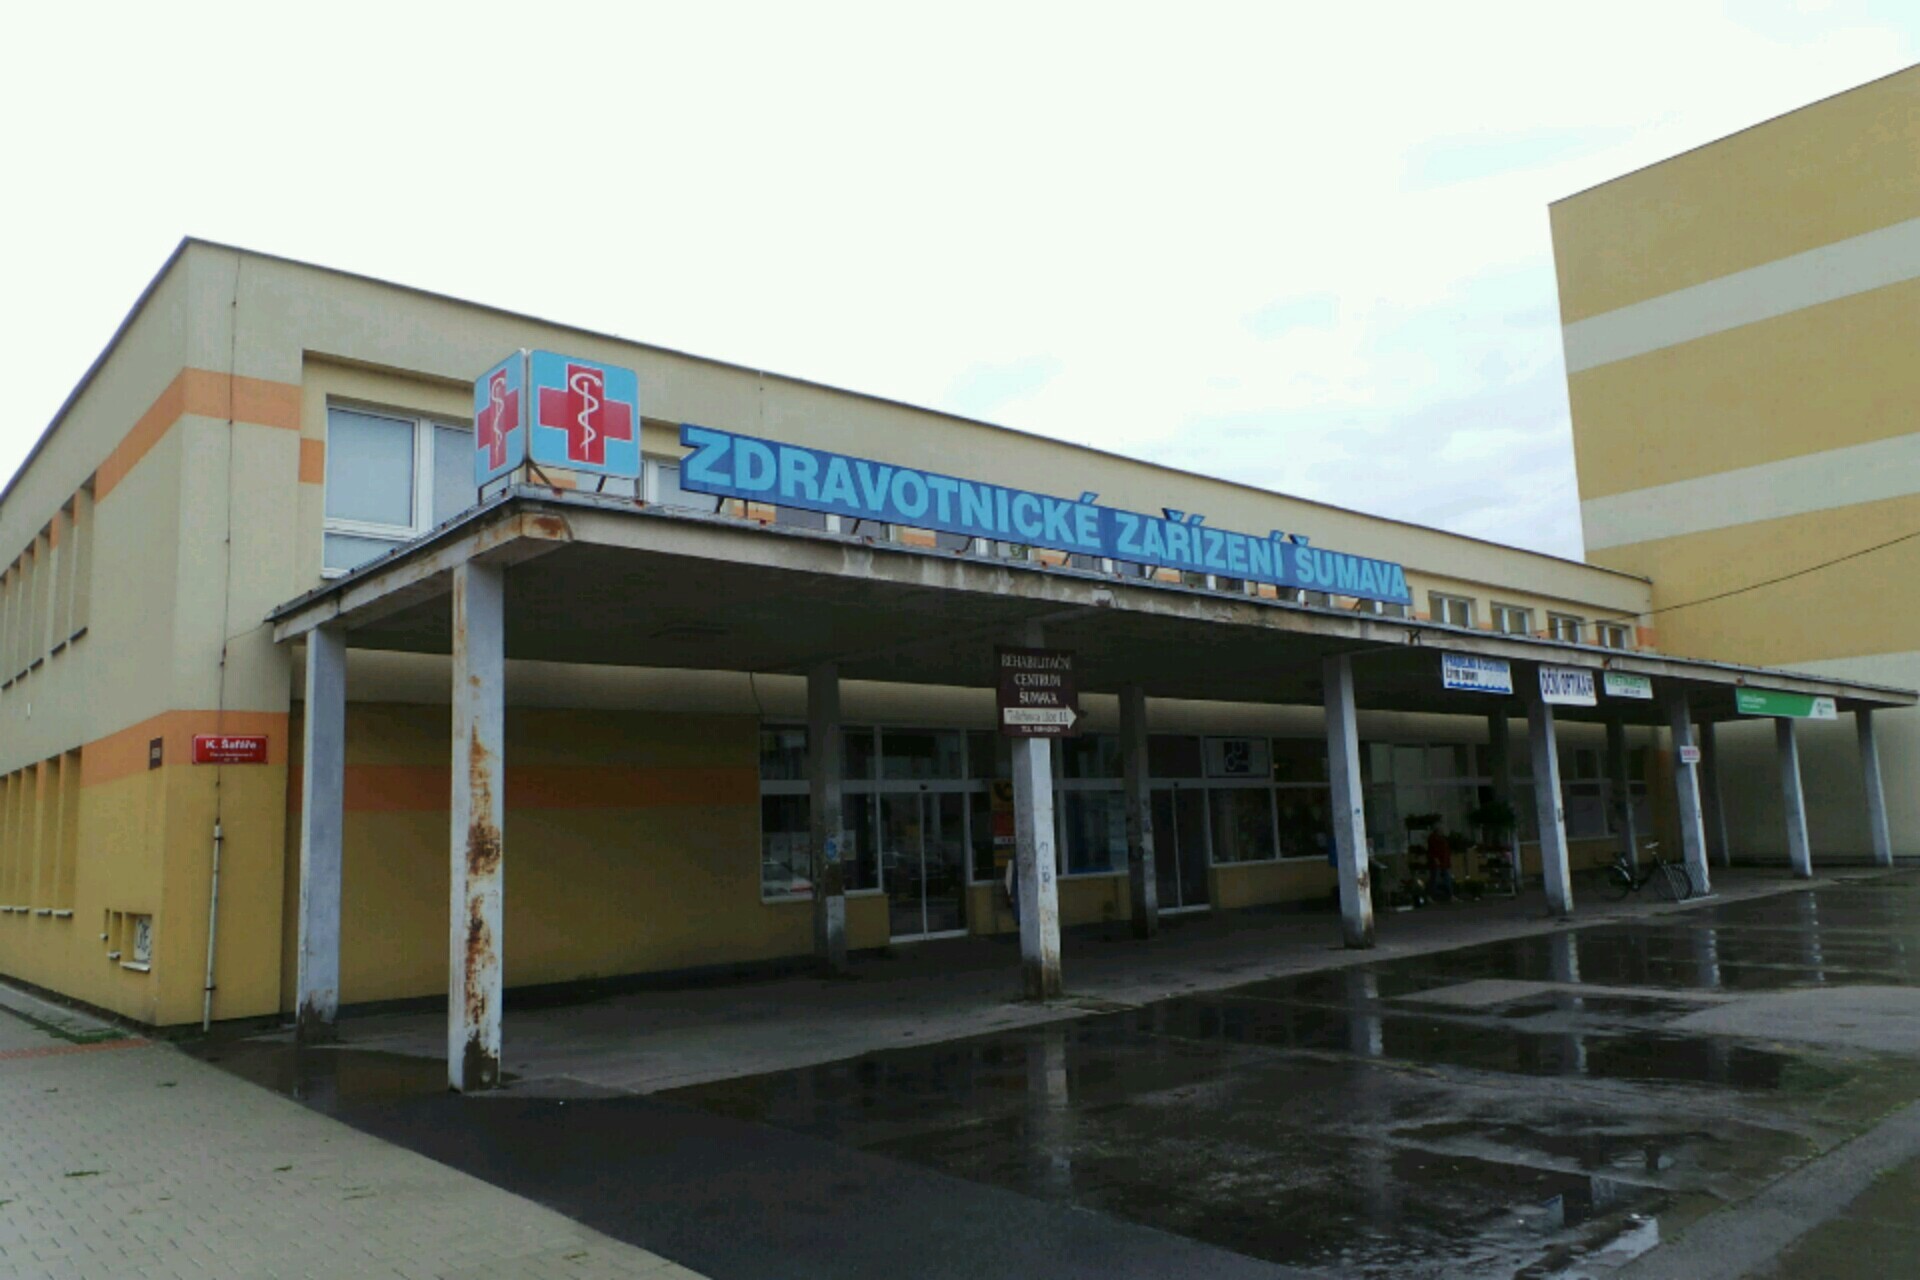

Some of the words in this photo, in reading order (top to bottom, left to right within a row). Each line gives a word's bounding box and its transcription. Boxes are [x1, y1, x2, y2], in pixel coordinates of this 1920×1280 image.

[684, 424, 1099, 548] ZDRAVOTNICKÉ
[1113, 508, 1285, 579] ZAŘÍZENÍ
[1290, 534, 1411, 601] ŠUMAVA
[1001, 653, 1072, 671] REHABILITAČNÍ
[1014, 672, 1061, 688] CENTRUM
[1541, 667, 1560, 695] OČNÍ
[1019, 688, 1059, 705] ŠUMAVA
[205, 739, 219, 749] K.
[221, 738, 257, 750] Šafáře
